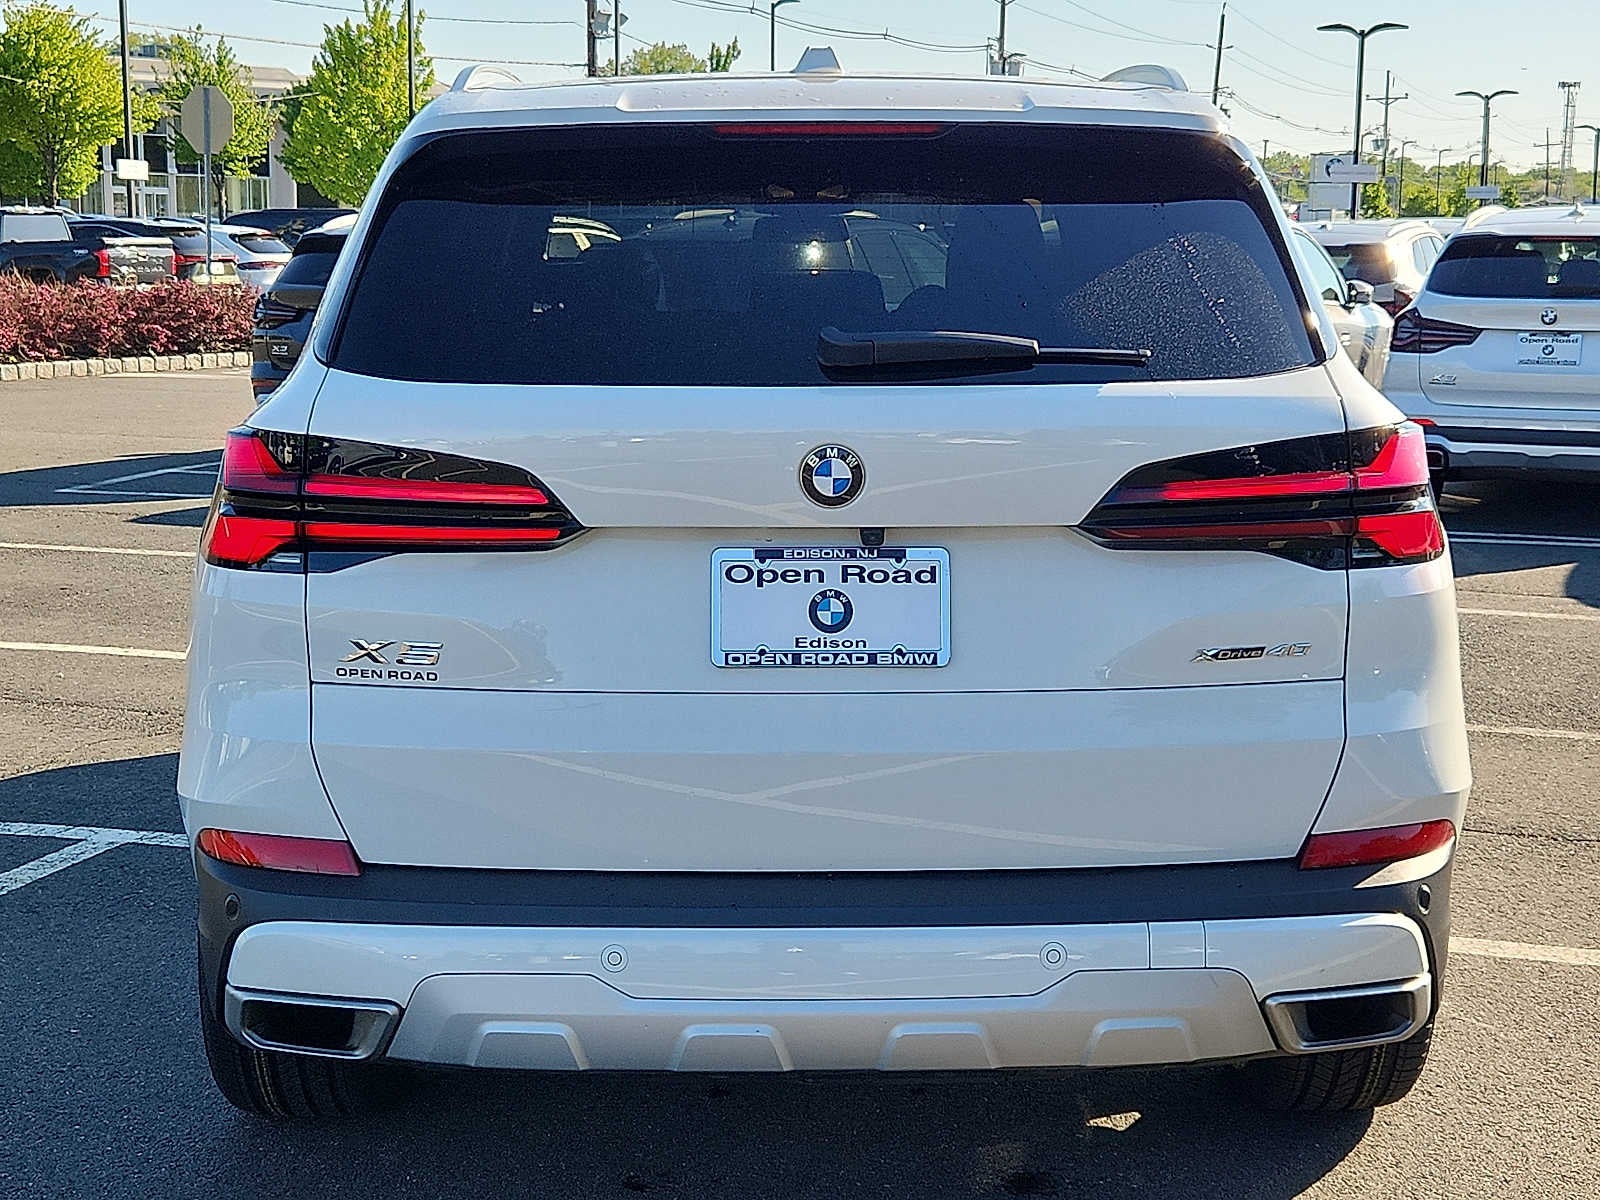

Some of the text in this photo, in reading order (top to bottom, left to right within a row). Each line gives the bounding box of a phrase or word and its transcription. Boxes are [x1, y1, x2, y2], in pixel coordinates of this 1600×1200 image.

[806, 447, 859, 468] BMW
[856, 549, 878, 559] NJ
[724, 564, 937, 588] Open Road
[814, 590, 849, 603] BMW
[794, 637, 867, 649] Edison
[337, 639, 444, 665] X5
[727, 653, 935, 665] OPEN ROAD BMW
[336, 668, 438, 681] OPEN ROAD
